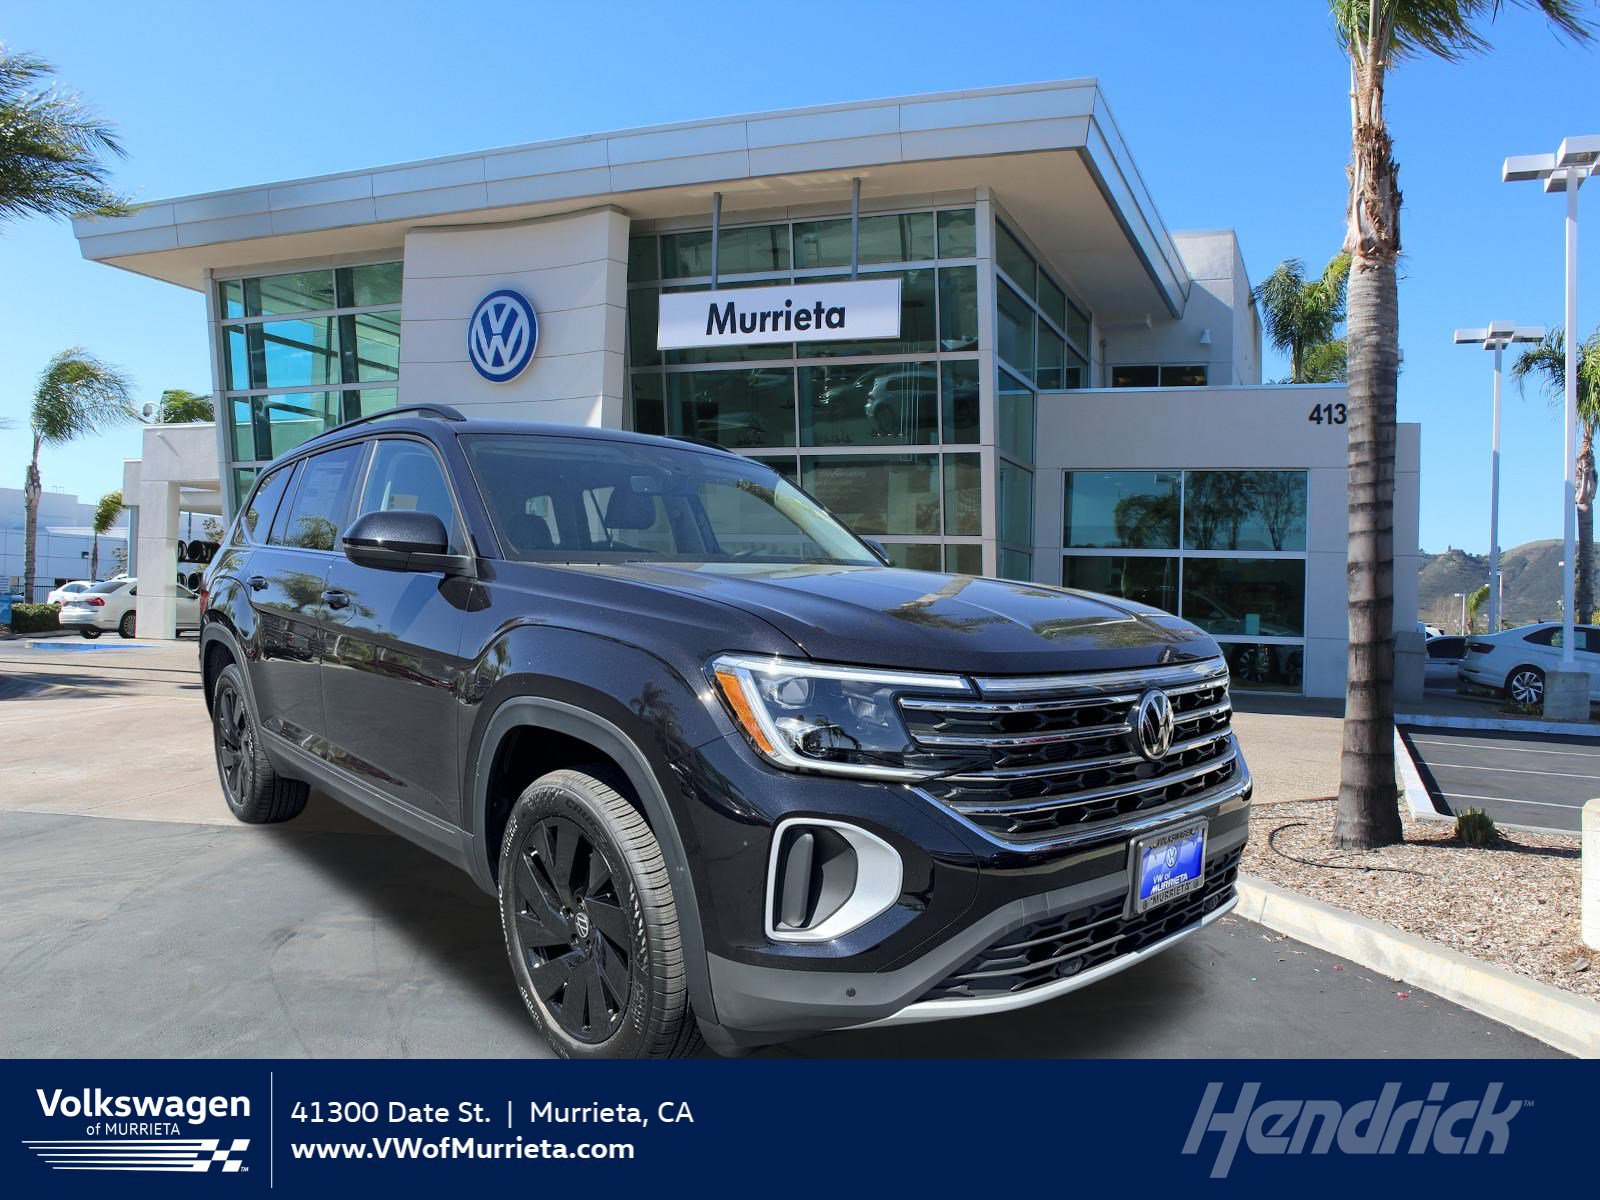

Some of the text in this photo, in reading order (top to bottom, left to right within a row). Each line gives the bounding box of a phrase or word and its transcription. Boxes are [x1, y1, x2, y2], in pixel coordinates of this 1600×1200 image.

[705, 299, 846, 336] Murrieta
[1308, 403, 1347, 425] 413
[1150, 872, 1189, 895] MURRIETA
